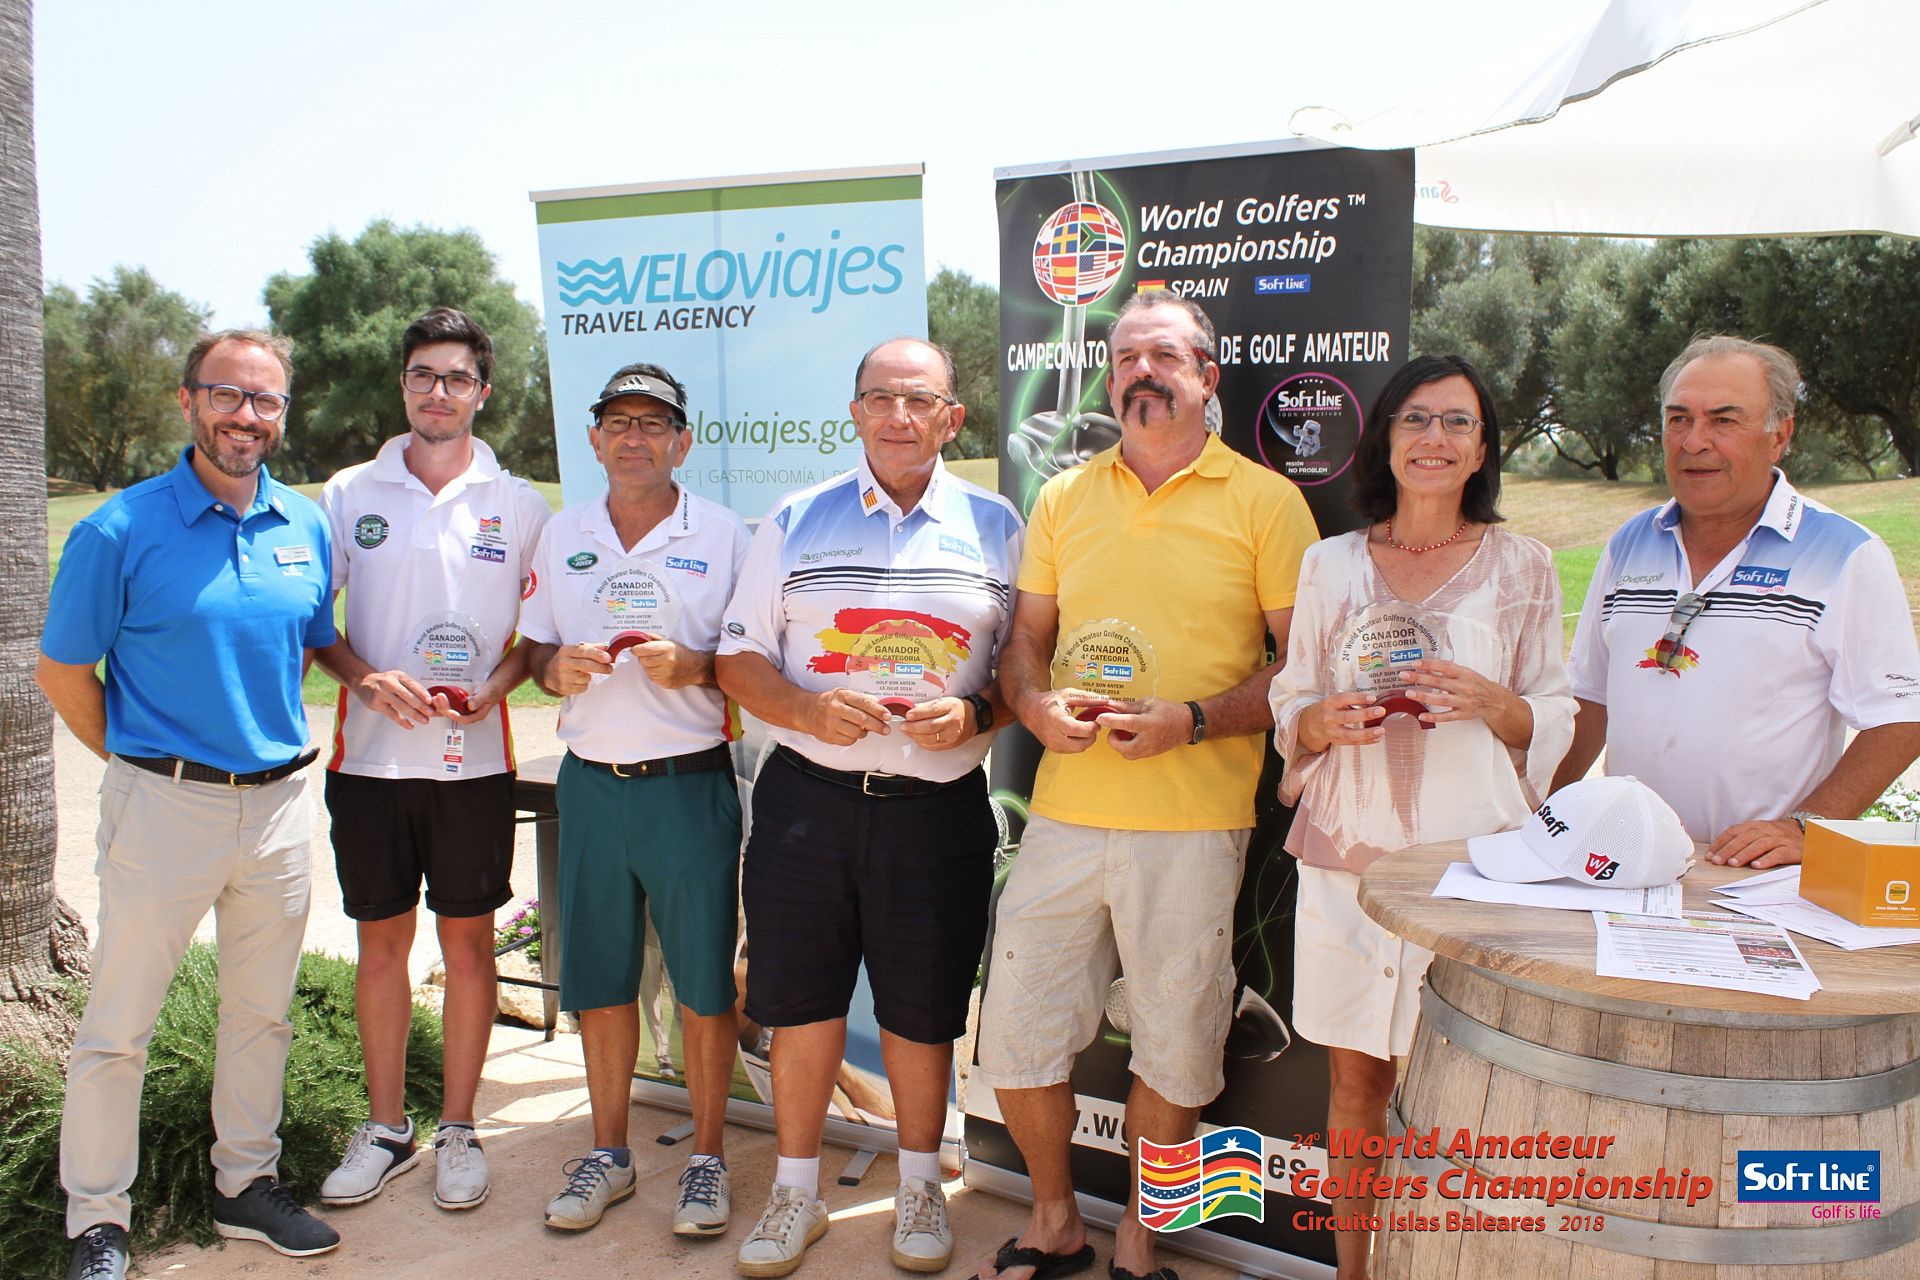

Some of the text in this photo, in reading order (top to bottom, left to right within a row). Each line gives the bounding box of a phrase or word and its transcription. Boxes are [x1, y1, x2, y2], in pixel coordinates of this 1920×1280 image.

[1140, 199, 1221, 232] World
[1236, 194, 1340, 226] Golfers
[1137, 231, 1336, 269] Championship
[1170, 277, 1229, 299] SPAIN
[561, 305, 756, 335] TRAVEL AGENCY
[1007, 331, 1390, 372] CAMPEONATO DE GOLF AMATEUR
[709, 465, 815, 484] GASTRONOMÍA
[429, 634, 466, 642] GANADOR
[1345, 632, 1359, 650] World
[1357, 616, 1382, 634] Amateur
[1383, 613, 1406, 623] Golfers
[1407, 617, 1438, 652] Championship
[1362, 627, 1415, 641] GANADOR
[1373, 638, 1418, 649] CATEGORIA
[875, 645, 920, 655] GANADOR
[1066, 641, 1080, 657] World
[1079, 631, 1102, 645] Amateur
[1103, 630, 1124, 641] Golfers
[1123, 636, 1147, 673] Championship
[1082, 644, 1129, 655] GANADOR
[1090, 655, 1130, 663] CATEGORIA
[1538, 805, 1570, 838] Staff
